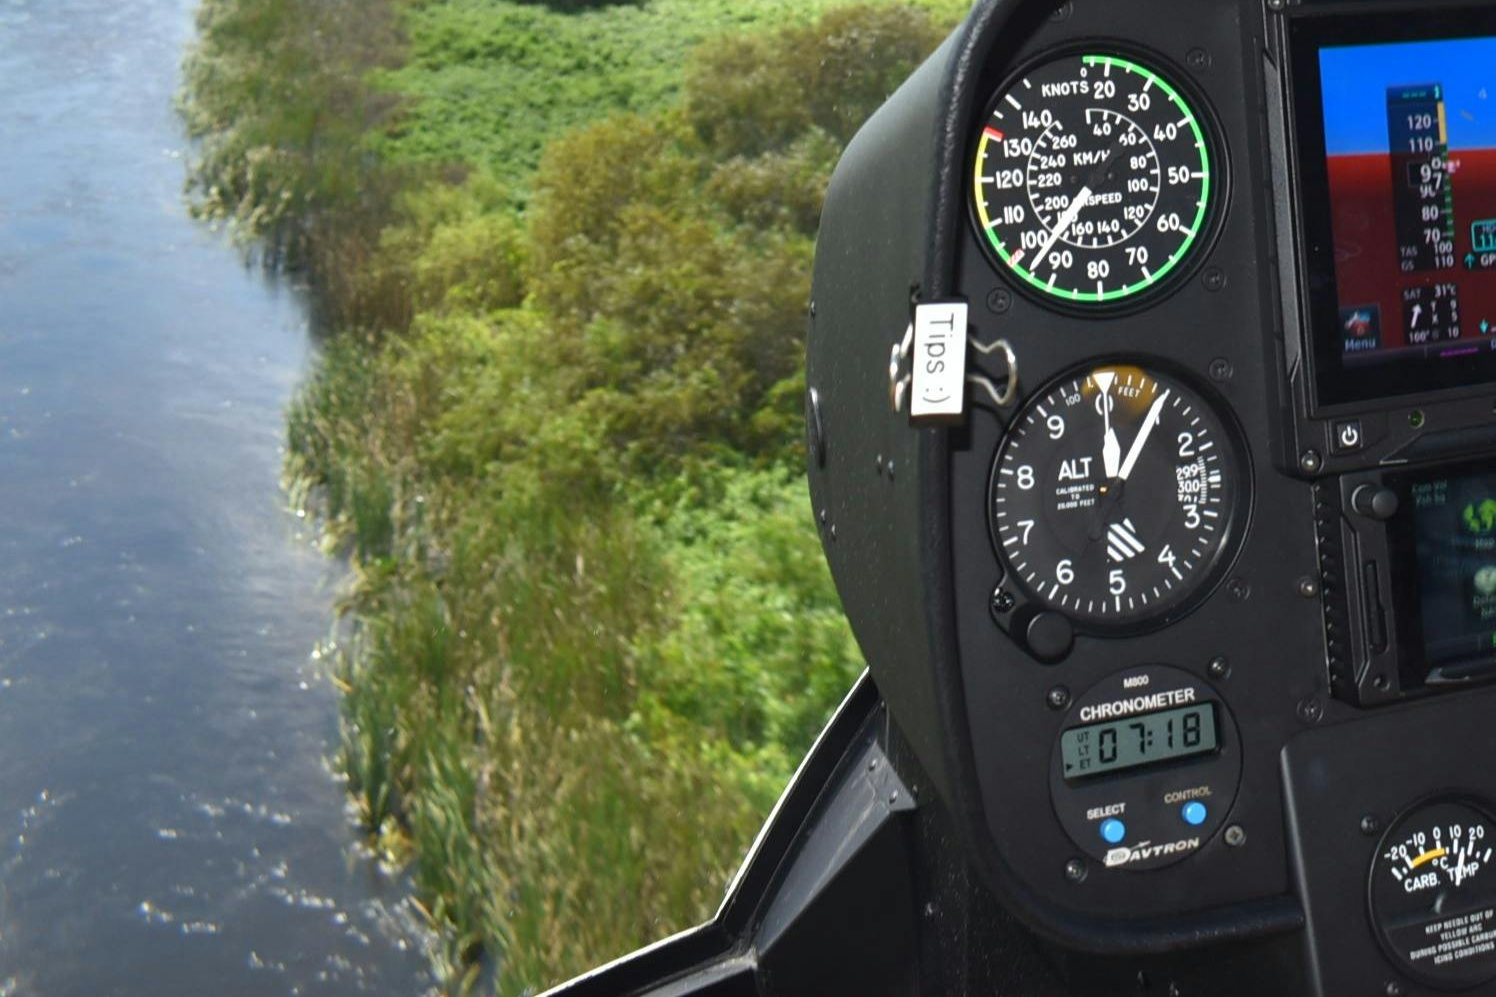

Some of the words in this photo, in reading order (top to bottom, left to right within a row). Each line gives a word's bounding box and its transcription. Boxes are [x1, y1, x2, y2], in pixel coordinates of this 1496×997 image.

[1080, 67, 1088, 78] 0
[1042, 81, 1089, 97] KNOTS
[1094, 81, 1115, 98] 20
[1127, 93, 1150, 111] 30
[1022, 110, 1052, 129] 140
[1407, 114, 1432, 130] 120
[1093, 123, 1111, 136] 40
[1154, 123, 1177, 141] 40
[1003, 138, 1032, 157] 130
[1052, 134, 1077, 149] 260
[1409, 137, 1434, 153] 110
[1040, 154, 1066, 169] 240
[1130, 156, 1146, 170] 80
[996, 170, 1023, 188] 120
[1037, 172, 1062, 187] 220
[1168, 167, 1190, 184] 50
[1127, 178, 1148, 193] 100
[1044, 195, 1069, 211] 200
[1004, 205, 1024, 224] 110
[1123, 206, 1144, 220] 120
[1421, 205, 1439, 221] 80
[1071, 221, 1094, 235] 160
[1097, 219, 1119, 234] 140
[1156, 213, 1179, 231] 60
[1020, 230, 1048, 249] 100
[1424, 229, 1441, 244] 70
[1125, 247, 1148, 264] 70
[1434, 242, 1452, 254] 100
[1049, 251, 1073, 268] 90
[1435, 255, 1454, 268] 110
[1087, 260, 1109, 279] 80
[1404, 288, 1421, 299] SAT
[923, 313, 954, 374] Tips
[1344, 337, 1376, 352] Menu
[1065, 393, 1081, 406] 100
[1118, 386, 1141, 398] FEET
[1047, 415, 1065, 439] 9
[1177, 432, 1195, 457] 2
[1058, 456, 1092, 481] ALT
[1017, 465, 1035, 490] 8
[1183, 505, 1200, 529] 3
[1017, 520, 1035, 545] 7
[1157, 544, 1176, 567] 4
[1056, 560, 1074, 584] 6
[1109, 570, 1126, 595] 5
[1123, 675, 1149, 689] M800
[1080, 687, 1196, 722] CHRONOMETER
[1077, 731, 1090, 743] UT
[1099, 712, 1201, 764] 07:18
[1080, 758, 1092, 770] ET
[1164, 786, 1212, 804] CONTROL
[1086, 802, 1126, 820] SELECT
[1405, 832, 1426, 847] -10
[1432, 826, 1441, 840] 0
[1449, 824, 1462, 838] 10
[1468, 825, 1484, 840] 20
[1103, 838, 1200, 867] DAVTRON
[1384, 844, 1407, 861] -20
[1404, 872, 1441, 892] CARB.
[1425, 922, 1442, 934] KEEP
[1444, 916, 1468, 929] NEEDLE
[1470, 912, 1484, 922] OUT
[1485, 909, 1494, 919] OF
[1440, 927, 1467, 941] YELLOW
[1469, 923, 1482, 933] ARC
[1410, 947, 1437, 960] DURING
[1438, 939, 1470, 953] POSSIBLE
[1434, 952, 1453, 965] ICING
[1455, 942, 1495, 959] CONDITIONS
